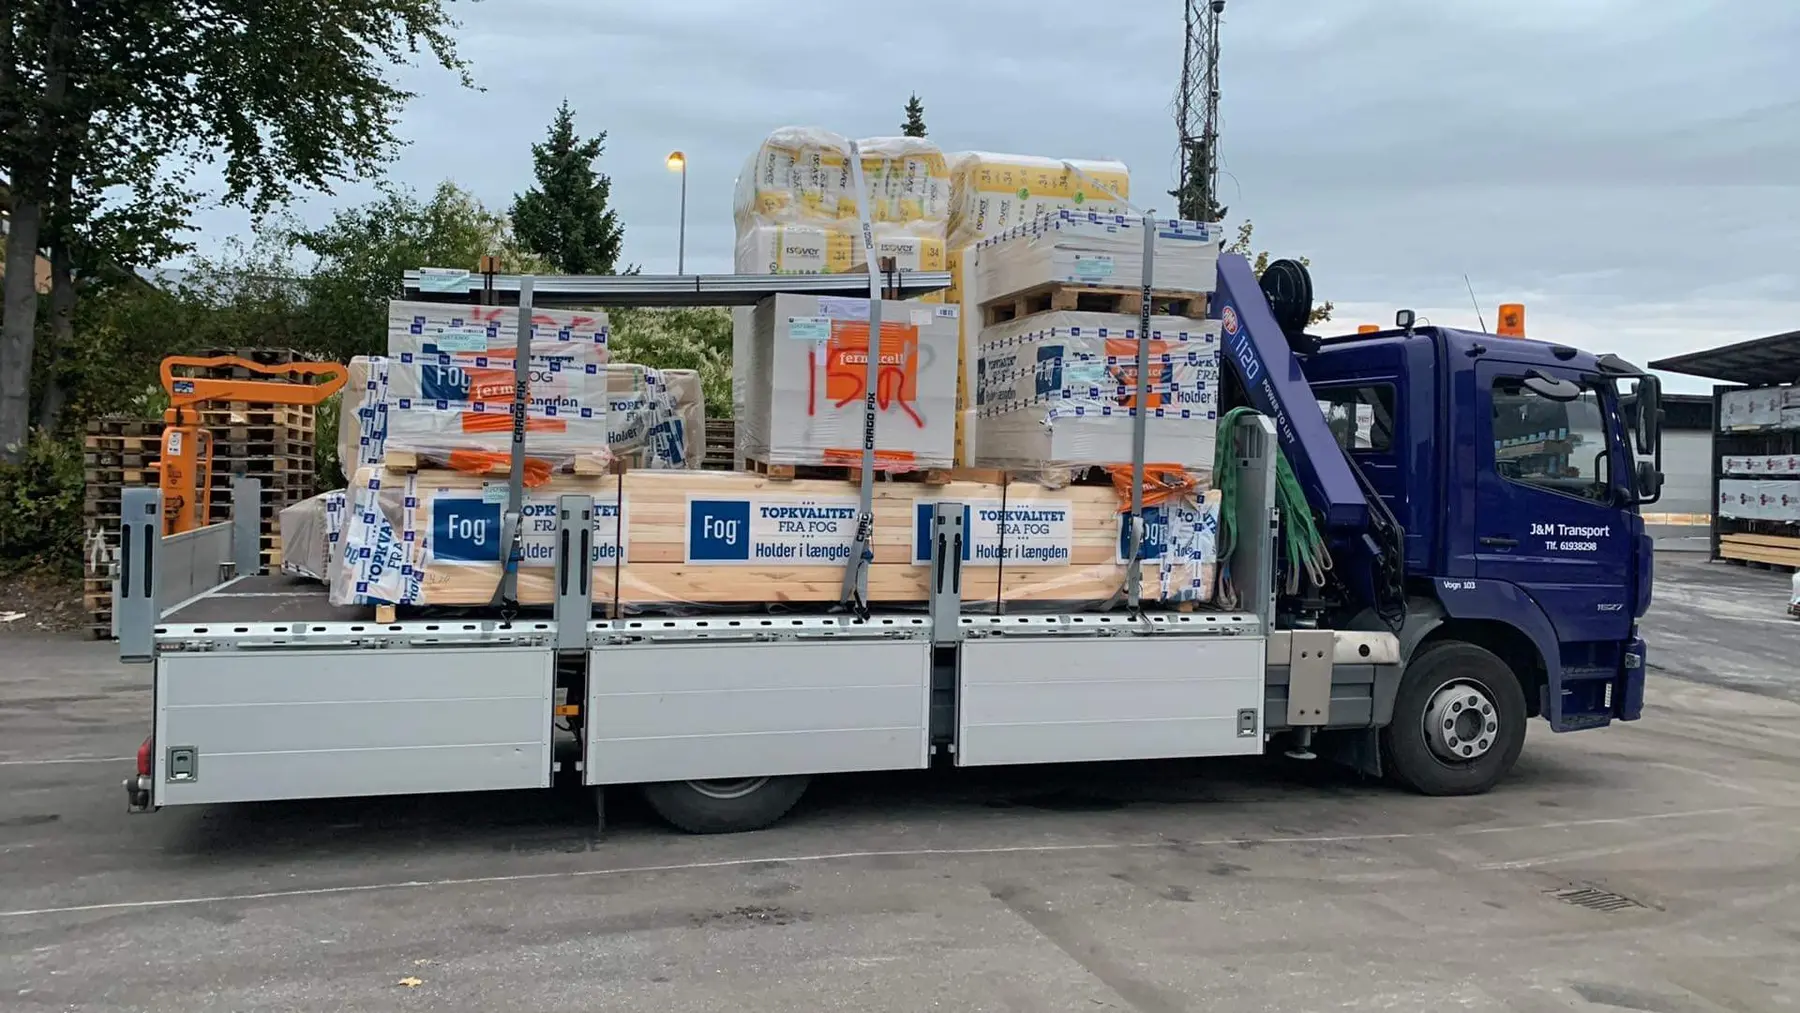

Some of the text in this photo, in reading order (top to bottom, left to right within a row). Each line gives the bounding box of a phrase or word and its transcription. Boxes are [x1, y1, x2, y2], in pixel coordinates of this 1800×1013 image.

[1141, 284, 1151, 339] CARGO FIX
[840, 352, 904, 365] fermcell
[1235, 335, 1260, 380] 1120
[514, 380, 526, 443] CARGO FIX
[1262, 378, 1296, 444] POWER TO LIFT
[865, 392, 876, 450] CARGO FIX
[760, 506, 856, 520] TOPKVALITET
[979, 510, 1066, 522] TOPKVALITET
[448, 513, 485, 545] Fog
[704, 515, 737, 545] Fog
[778, 521, 838, 533] FRA FOG
[996, 523, 1050, 535] FRA FOG
[1529, 523, 1611, 540] J&M Transport
[520, 543, 555, 559] older
[755, 542, 851, 561] Holder i længde
[976, 544, 1068, 562] Holder i længden
[1443, 580, 1476, 590] Vogn 103
